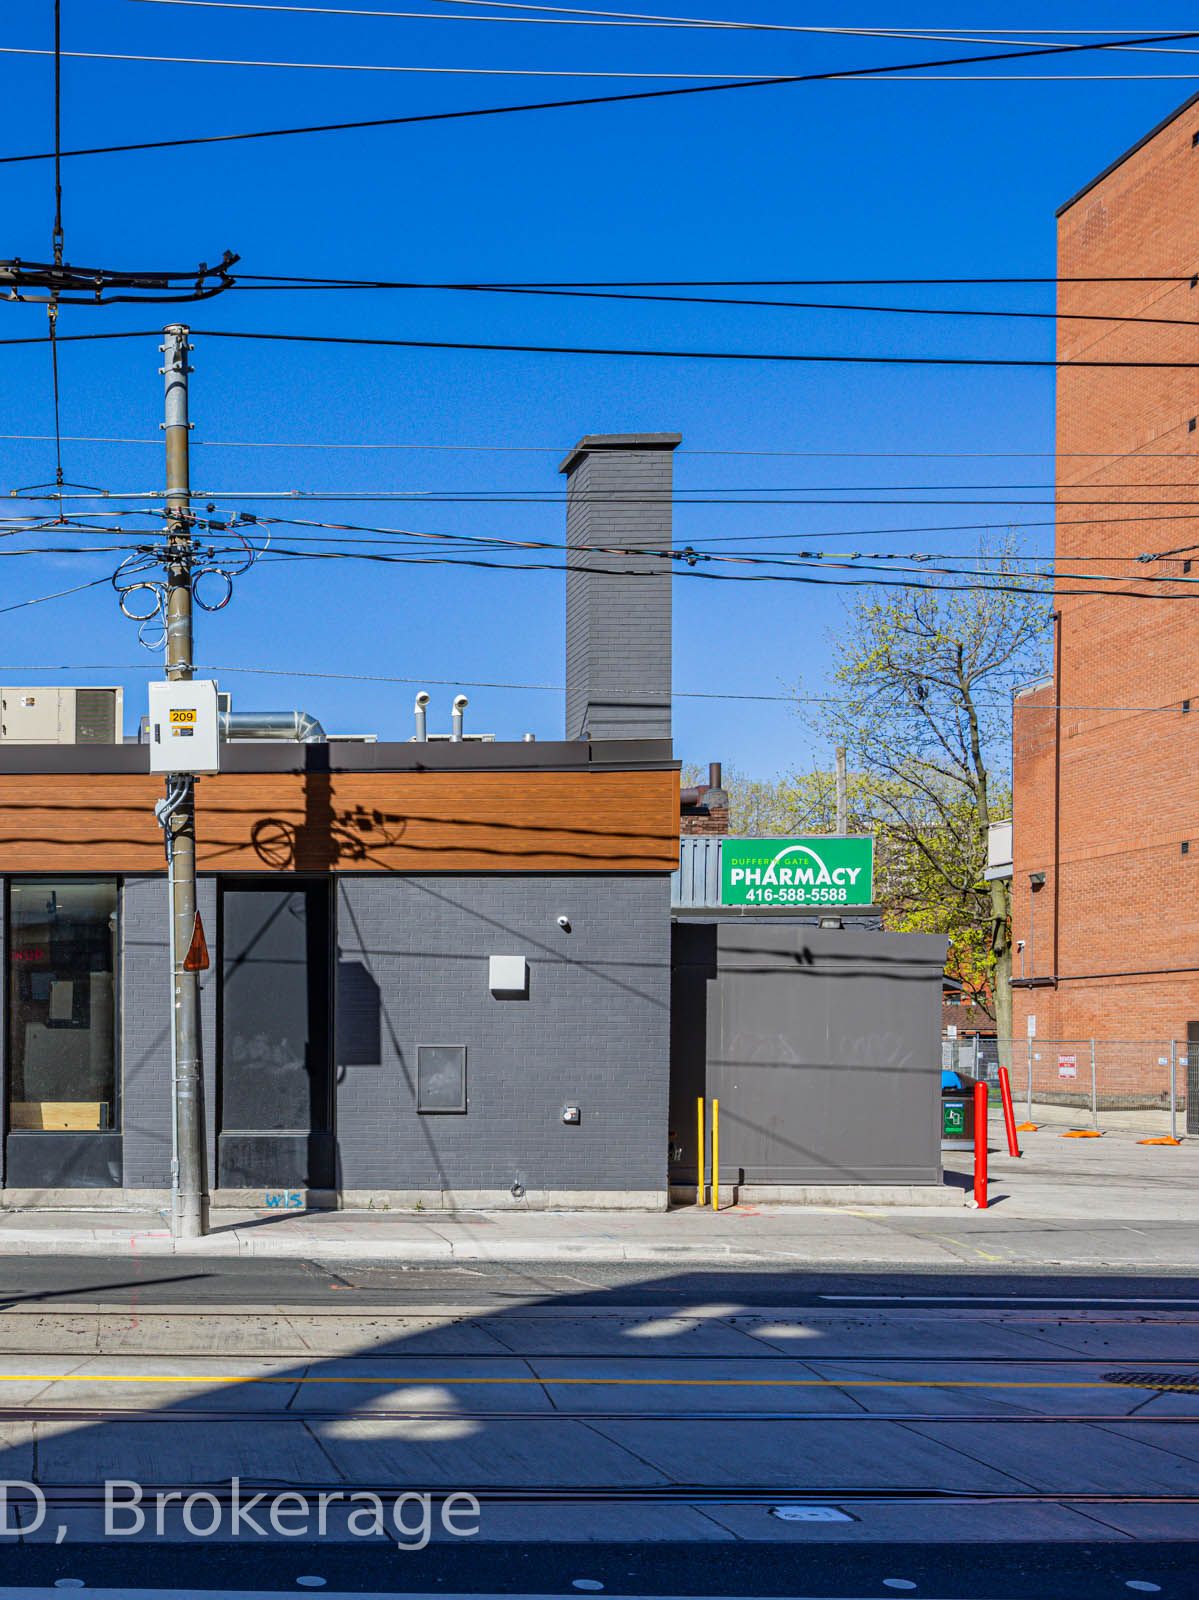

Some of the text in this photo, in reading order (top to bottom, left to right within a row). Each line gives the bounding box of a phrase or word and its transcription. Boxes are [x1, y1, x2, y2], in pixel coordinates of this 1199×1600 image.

[173, 712, 193, 722] 209
[730, 867, 862, 885] PHARMACY
[745, 888, 847, 902] 416-588-5588
